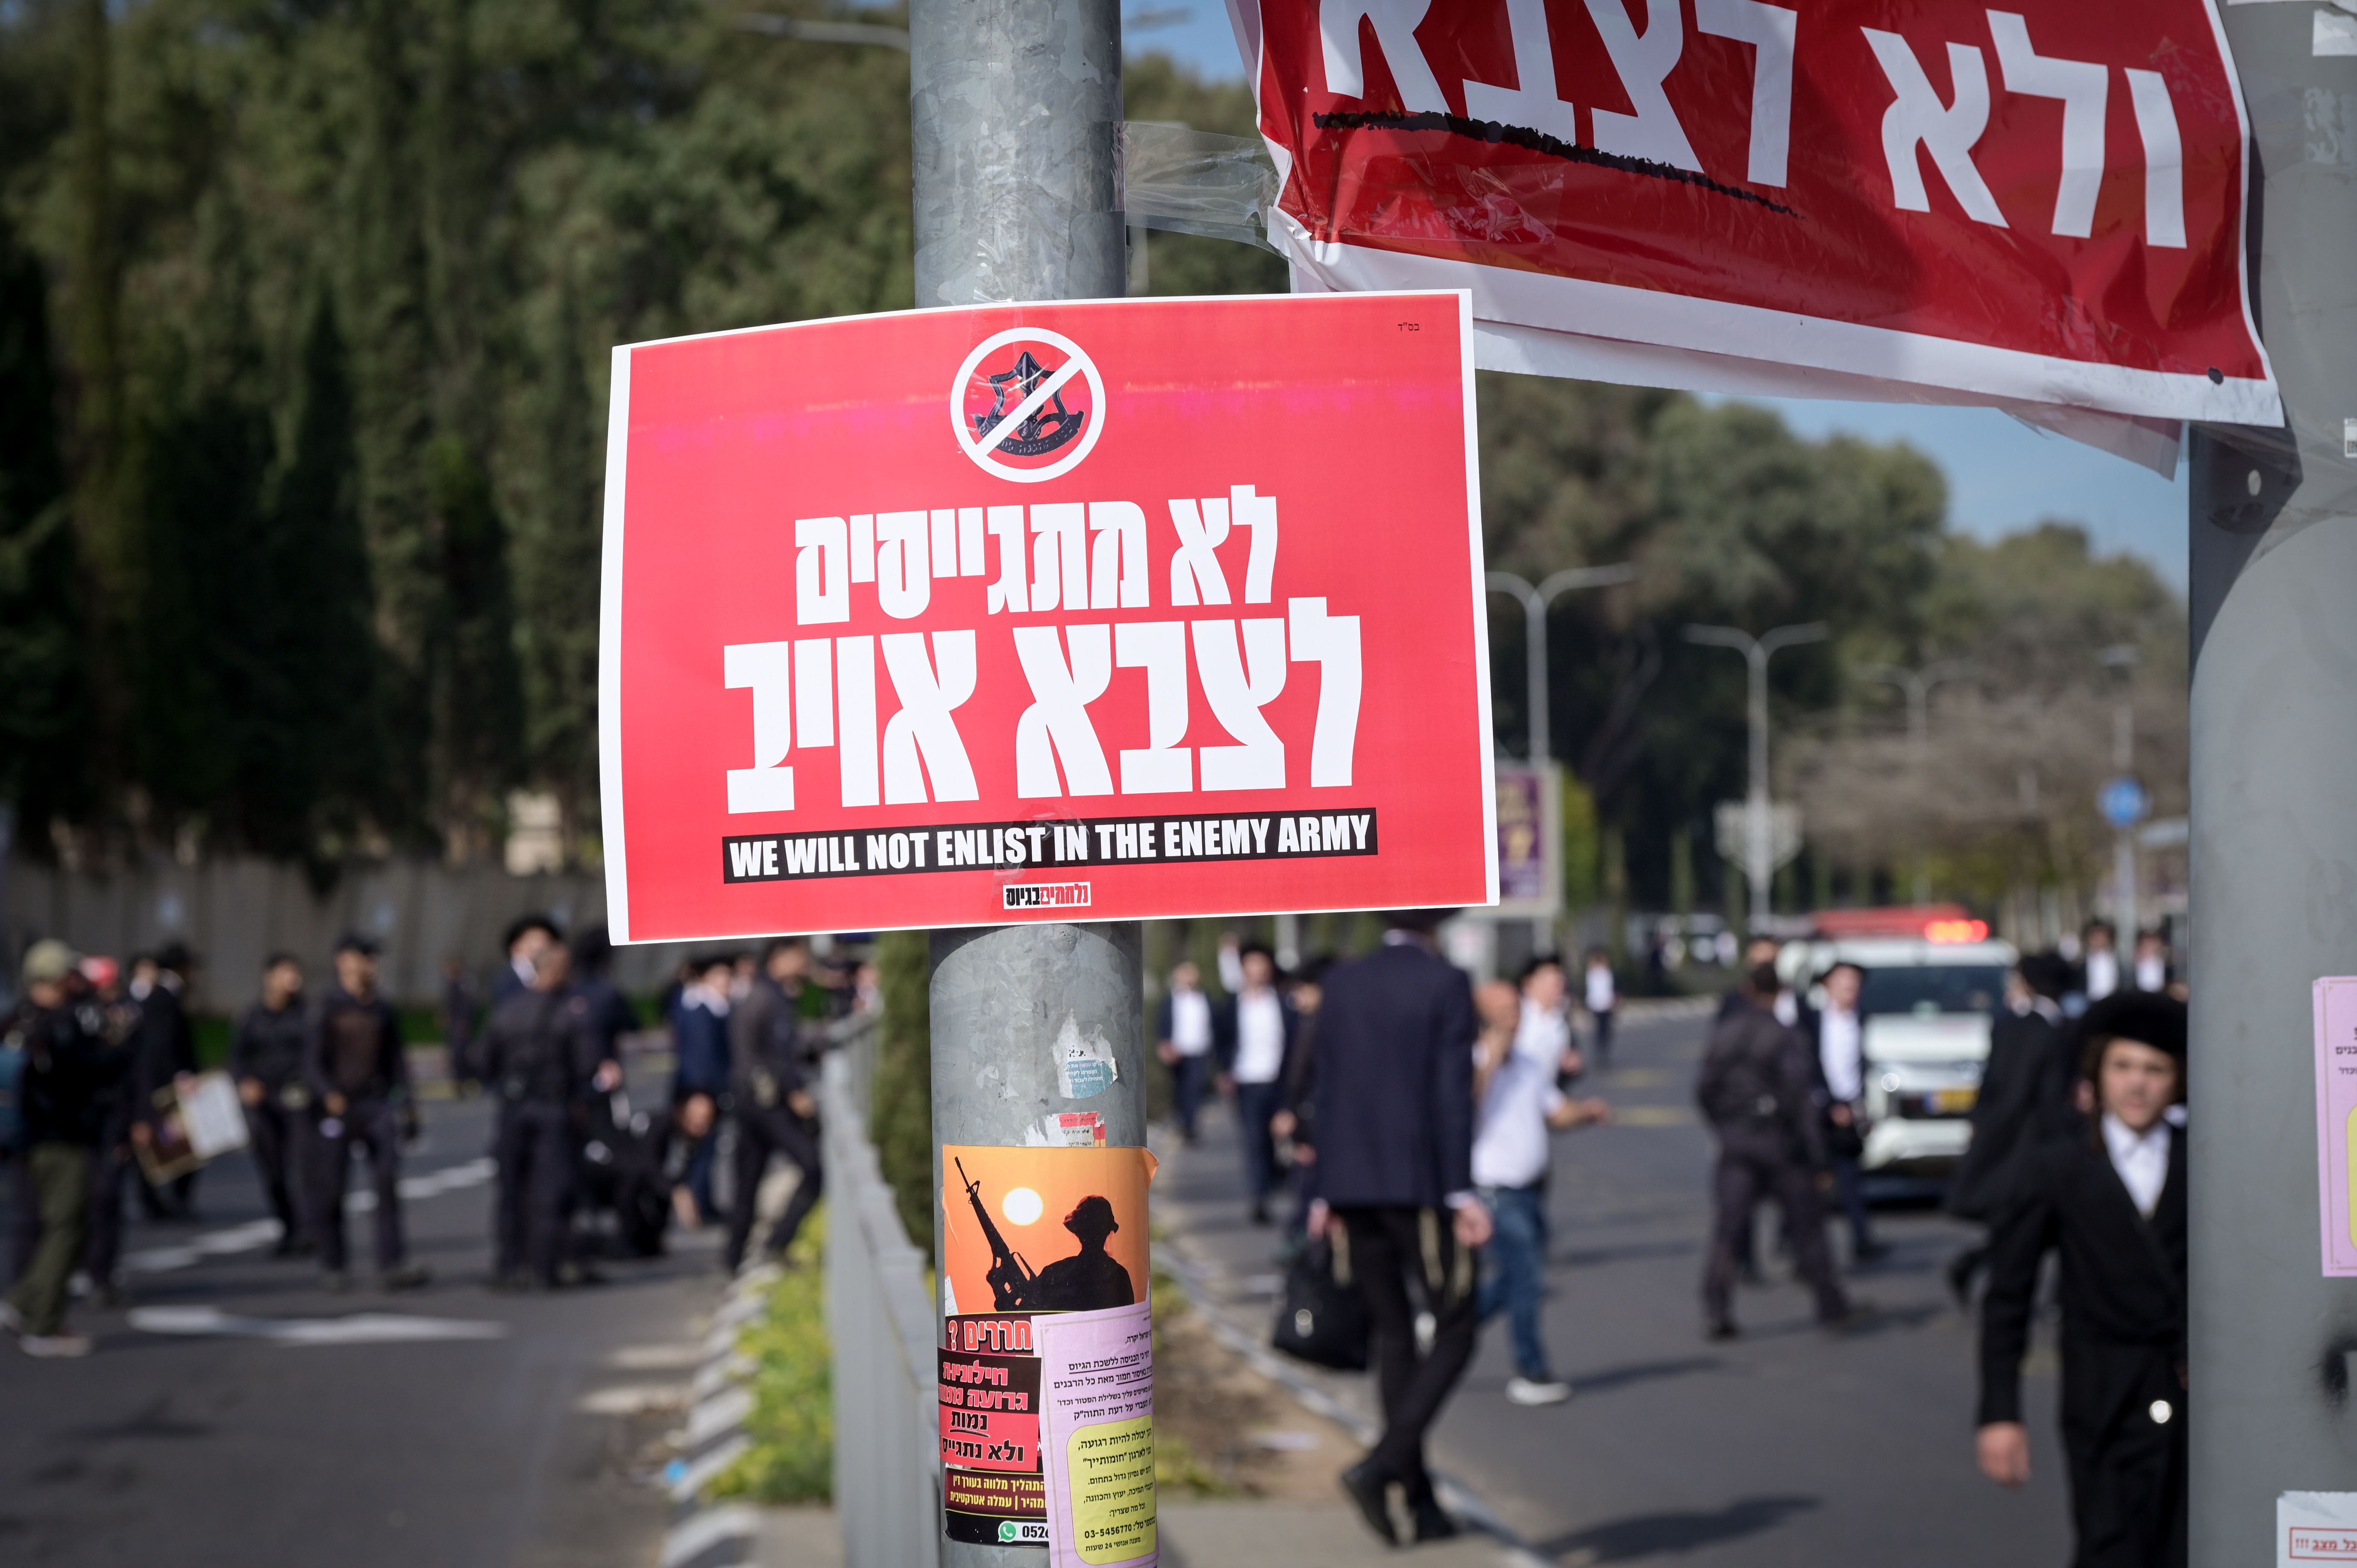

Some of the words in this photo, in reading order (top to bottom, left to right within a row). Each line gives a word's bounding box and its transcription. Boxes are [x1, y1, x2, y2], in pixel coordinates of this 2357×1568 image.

[1861, 7, 2187, 249] ולא
[1397, 322, 1419, 331] בס"ד
[1168, 485, 1278, 606] לא
[795, 501, 1149, 625] מתגייסים
[1012, 597, 1362, 799] לצבא
[724, 629, 979, 814] אויב
[730, 841, 778, 877] WE
[784, 836, 859, 873] WILL
[866, 832, 929, 870] NOT
[936, 827, 1045, 866] ENLIST
[1054, 825, 1087, 862] IN
[1095, 823, 1156, 859] THE
[1164, 818, 1270, 857] ENEMY
[1277, 814, 1370, 853] ARMY
[1125, 1334, 1138, 1345] יקרה,
[1094, 1357, 1118, 1368] ללשכת
[1120, 1354, 1139, 1364] הכניסה
[1068, 1362, 1091, 1371] הגיוס
[943, 1360, 1008, 1386] חילוניות
[1116, 1372, 1131, 1381] חמור
[1132, 1369, 1146, 1378] באיסור
[1054, 1380, 1083, 1389] הרבנים
[1086, 1377, 1095, 1385] כל
[1098, 1375, 1114, 1384] מאת
[967, 1389, 1028, 1410] גרועה
[1075, 1396, 1096, 1404] הפטור
[1098, 1393, 1121, 1402] בשלילת
[1122, 1390, 1133, 1400] עליך
[1108, 1406, 1123, 1415] דעת
[1125, 1403, 1133, 1412] על
[951, 1410, 988, 1431] נמות
[1074, 1409, 1105, 1421] התוה"ק
[1110, 1432, 1130, 1445] להיות
[1132, 1429, 1145, 1441] יכולה
[1078, 1438, 1107, 1451] רגועה,
[987, 1439, 1024, 1462] ולא
[1129, 1446, 1145, 1462] לארגון
[1088, 1475, 1112, 1485] בתחום.
[1114, 1473, 1126, 1481] גדול
[1127, 1470, 1139, 1480] נסיון
[962, 1477, 981, 1489] בעורך
[983, 1478, 1008, 1490] מלווה
[1113, 1490, 1126, 1500] יעוץ
[1127, 1486, 1144, 1498] תמיכה,
[950, 1491, 985, 1505] אטרקטיבית
[987, 1495, 1012, 1507] עמלה
[1083, 1493, 1111, 1504] והכוונה,
[1109, 1507, 1130, 1518] שצריך:
[1084, 1524, 1132, 1539] 03-5456770
[1114, 1539, 1128, 1547] אנושי
[1129, 1537, 1141, 1545] מענה
[2313, 1539, 2337, 1550] מצב
[1086, 1544, 1103, 1552] שעות
